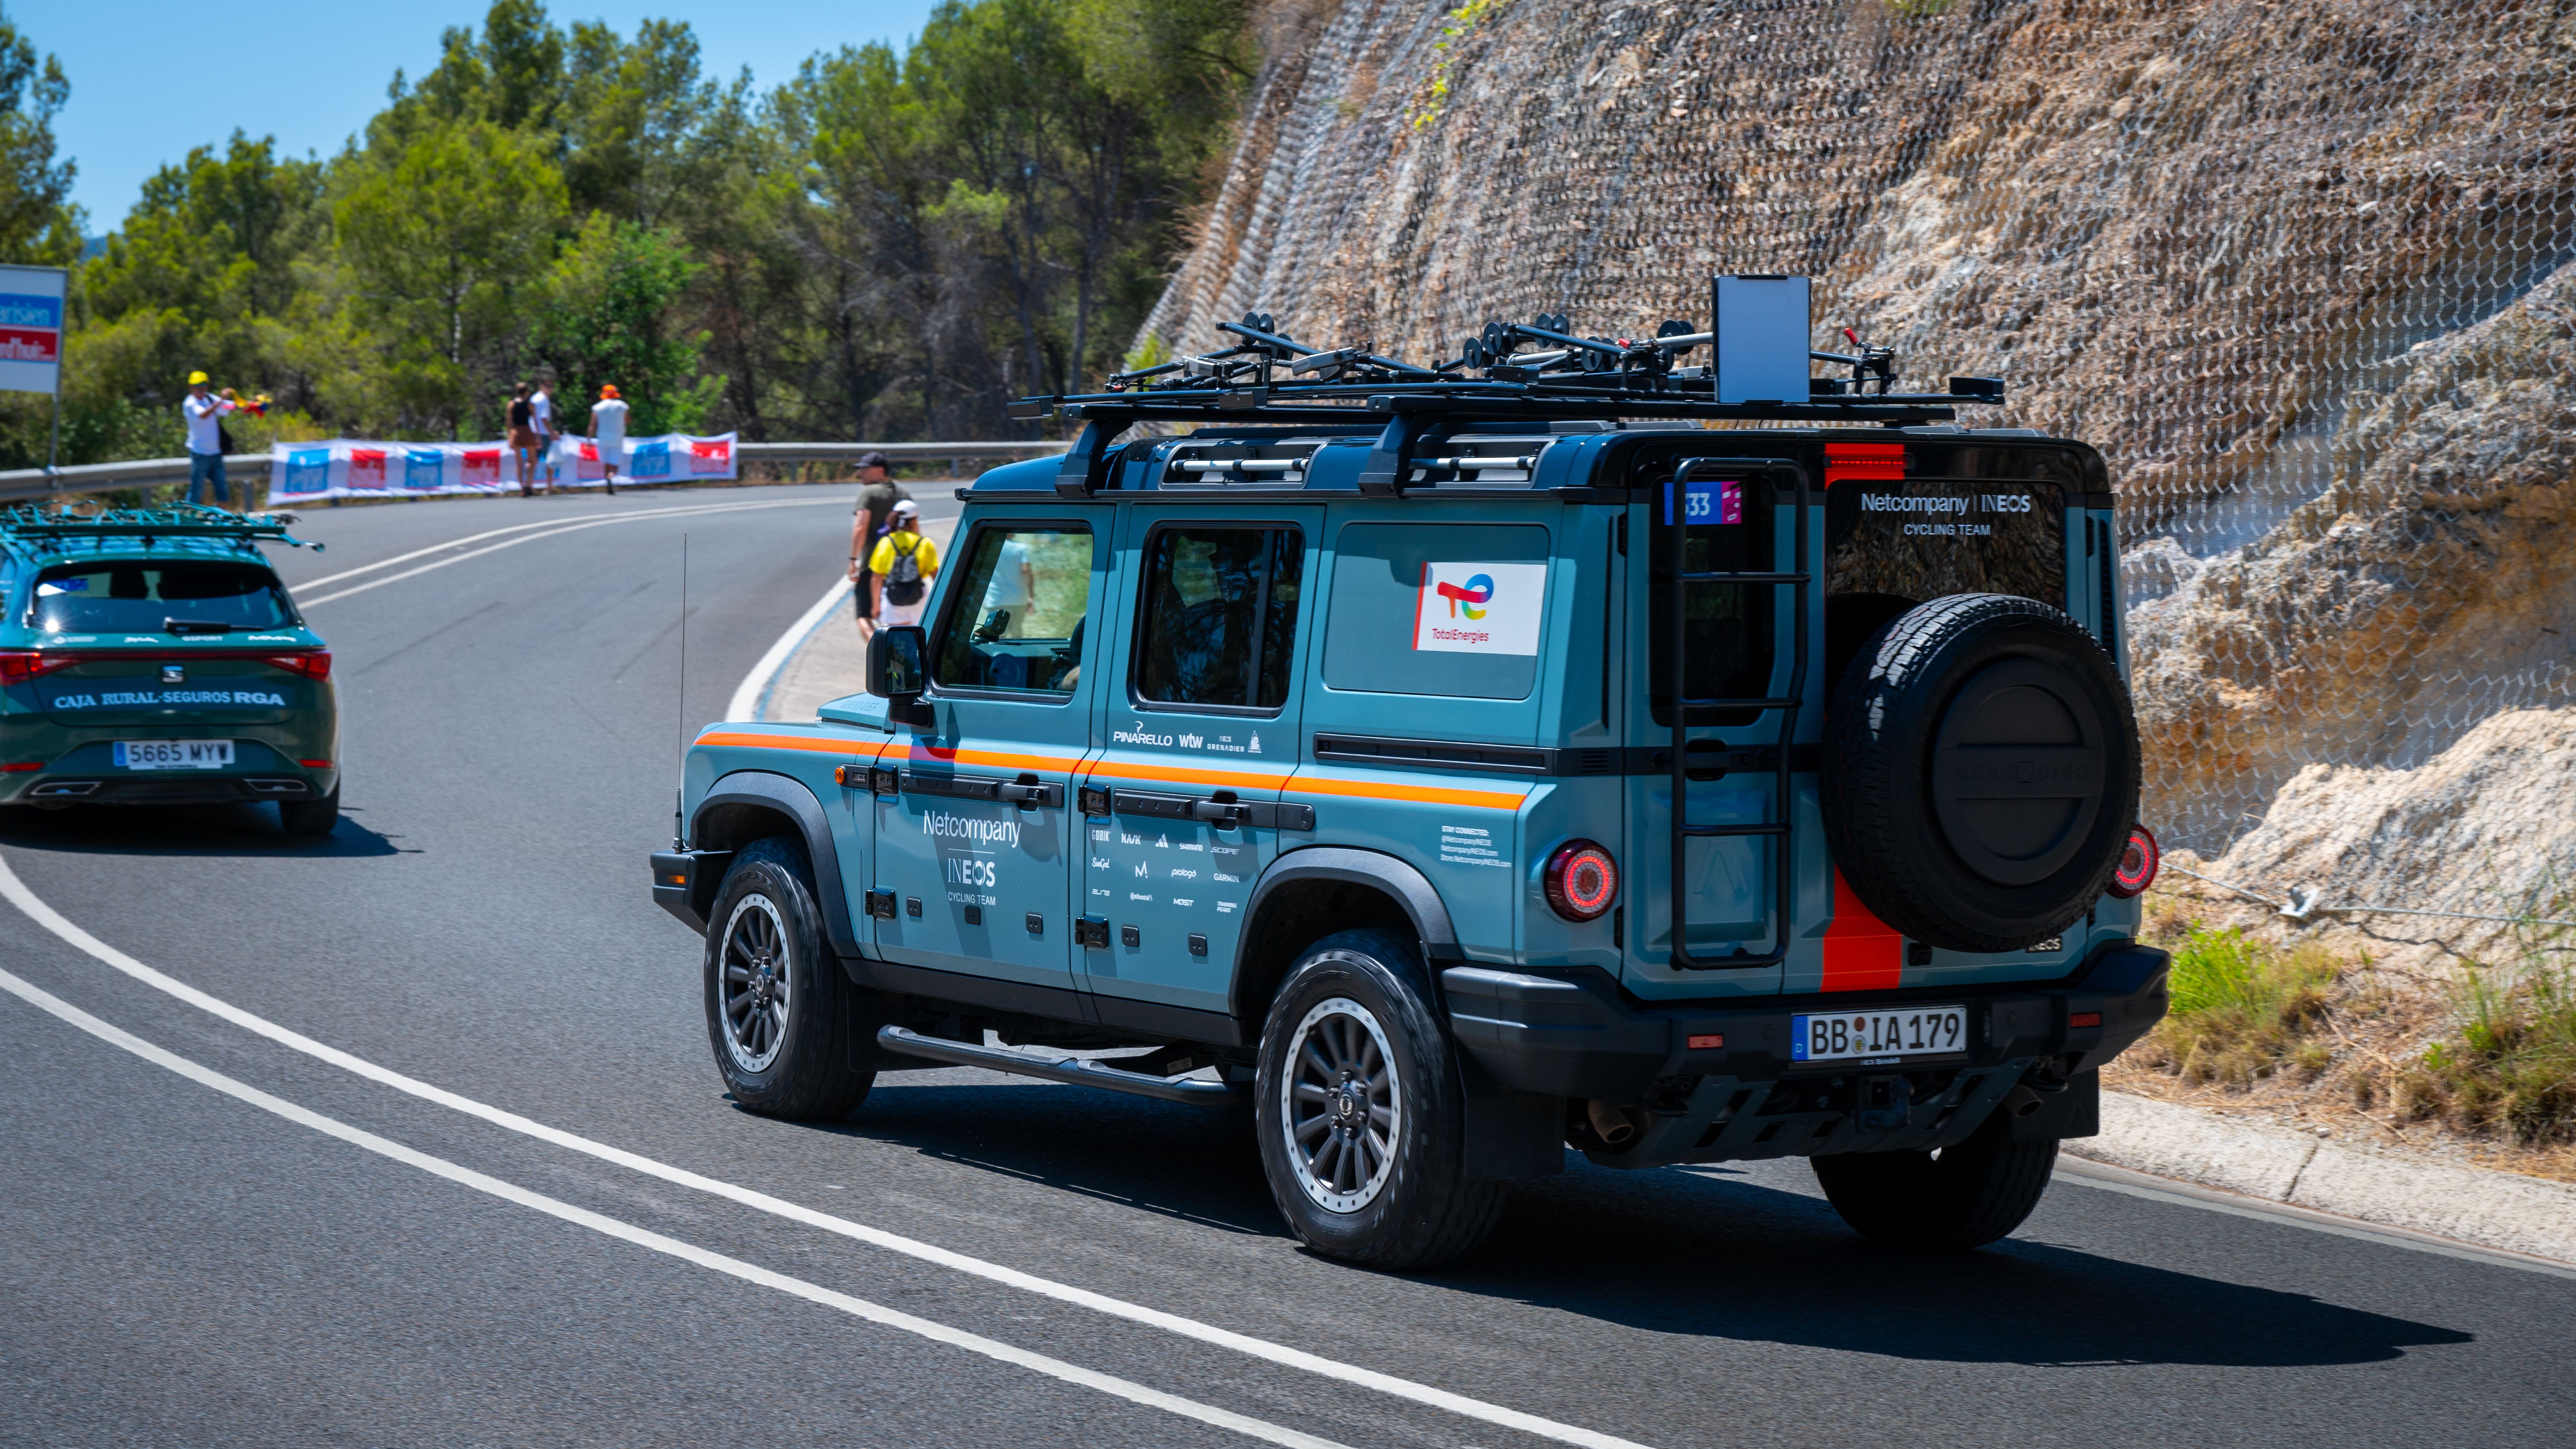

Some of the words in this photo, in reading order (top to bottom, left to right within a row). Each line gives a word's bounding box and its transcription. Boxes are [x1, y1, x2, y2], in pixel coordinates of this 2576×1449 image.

[1861, 493, 1970, 516] Netcompany
[1981, 494, 2031, 512] INEOS
[1904, 524, 1955, 535] CYCLING
[1958, 524, 1991, 535] TEAM
[1432, 628, 1489, 644] TotalEnergies
[54, 694, 97, 709] CAJA
[233, 692, 286, 706] RGA
[129, 745, 183, 762] 5665
[1207, 743, 1245, 753] GRENADIER
[923, 810, 1022, 848] Netcompany
[1092, 829, 1110, 842] GOBIK
[1179, 842, 1203, 851] SHIMANO
[1210, 846, 1240, 855] SCOPE
[1092, 857, 1110, 871] SunGod
[948, 858, 995, 887] INEOS
[1171, 868, 1197, 879] prologo
[1213, 873, 1240, 883] GARMIN
[948, 891, 976, 904] CYCLING
[977, 895, 996, 906] TEAM
[1173, 898, 1194, 907] MOST
[1796, 1043, 1804, 1053] D
[1812, 1020, 1849, 1055] BB
[1869, 1016, 1901, 1052] IA
[1909, 1013, 1959, 1049] 179
